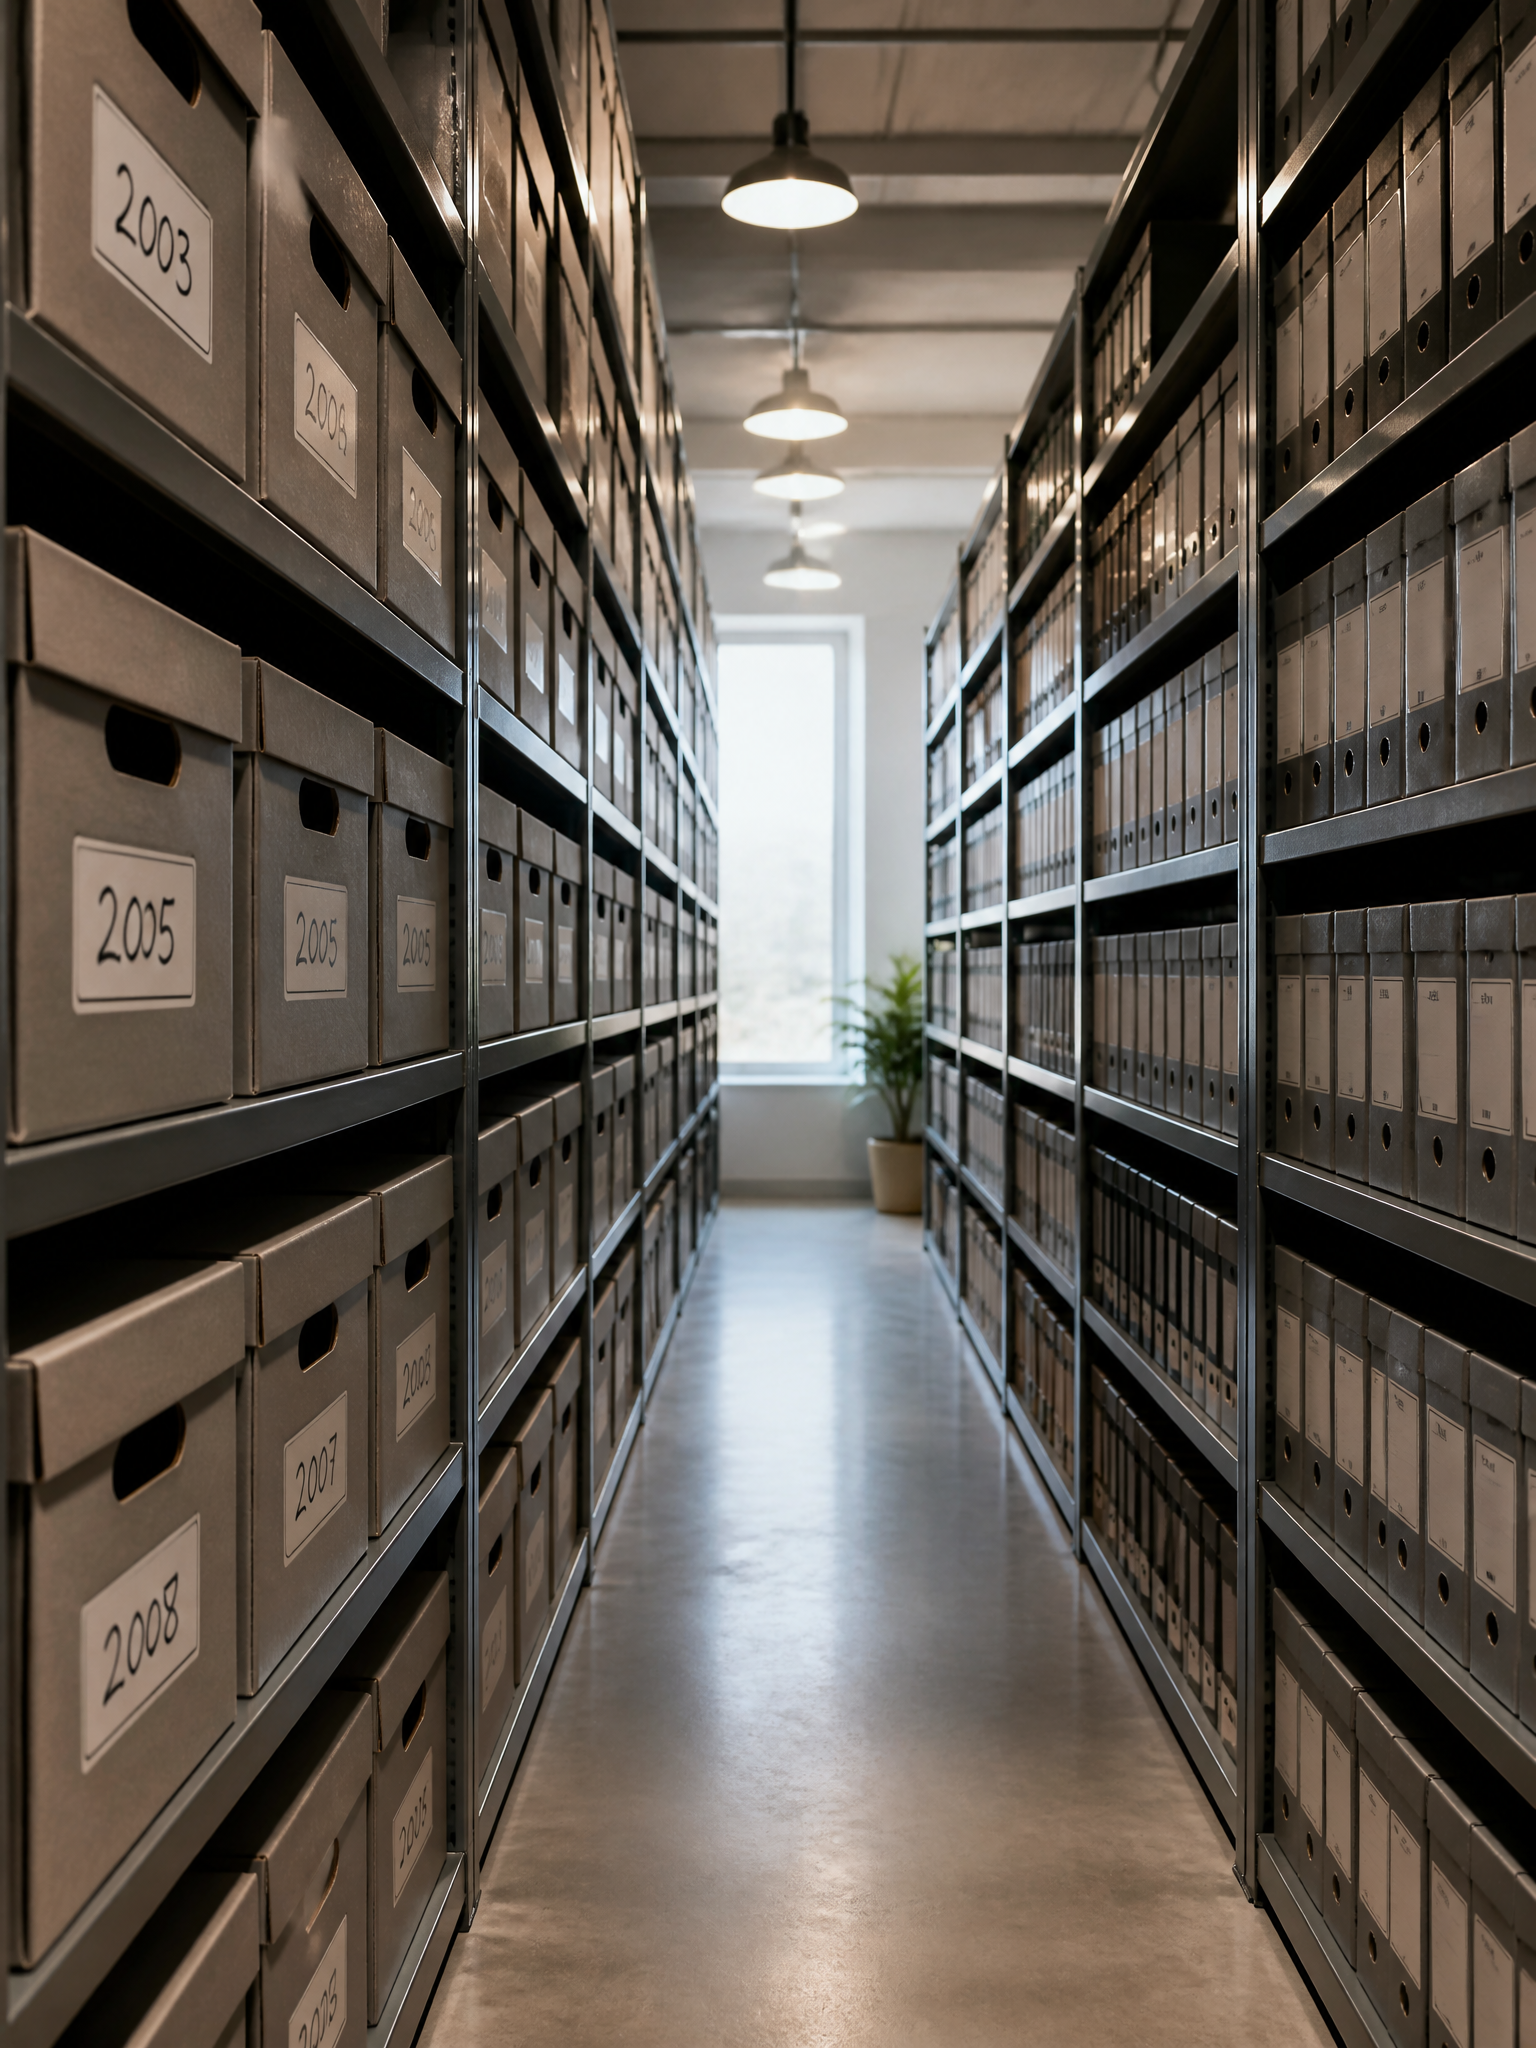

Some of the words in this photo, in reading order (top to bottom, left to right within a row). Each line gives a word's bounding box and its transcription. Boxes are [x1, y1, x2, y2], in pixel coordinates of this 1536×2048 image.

[115, 163, 192, 296] 2003
[97, 885, 175, 966] 2005
[295, 911, 337, 968] 2005
[402, 922, 431, 967] 2005
[294, 1432, 338, 1522] 2007
[103, 1571, 178, 1707] 2008
